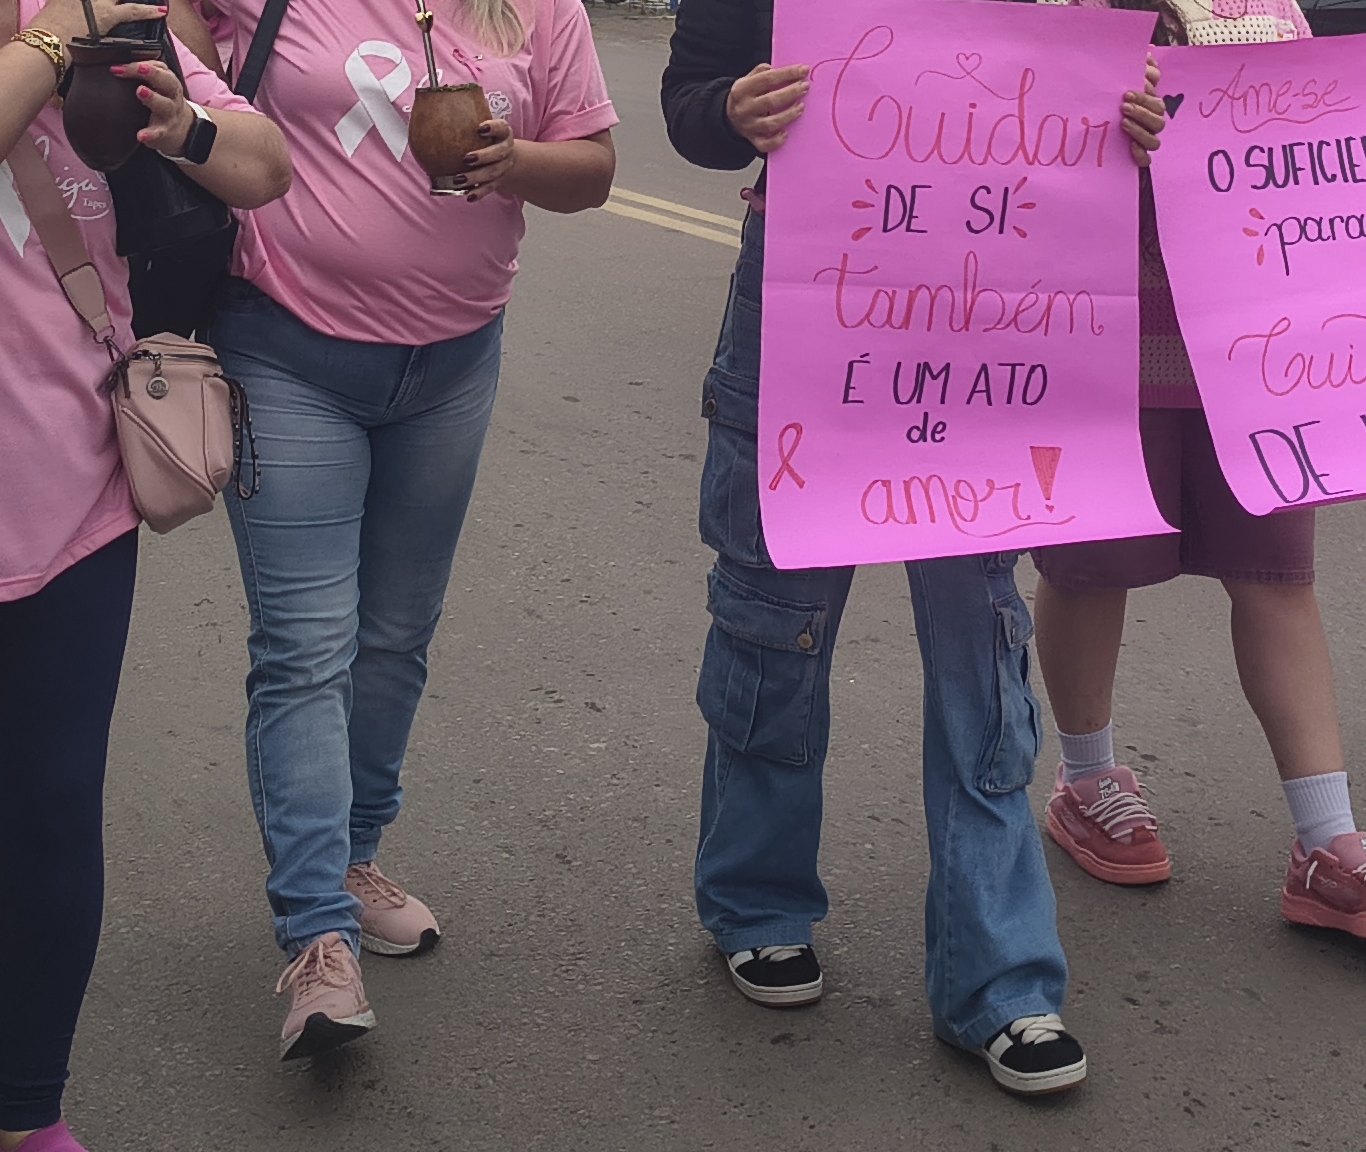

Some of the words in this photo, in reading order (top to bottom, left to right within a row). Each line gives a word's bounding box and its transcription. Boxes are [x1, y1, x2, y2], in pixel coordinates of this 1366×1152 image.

[810, 25, 1110, 168] Cuidar
[1207, 149, 1235, 192] O
[882, 184, 933, 234] DE
[965, 185, 1010, 235] SI
[813, 250, 1104, 337] também
[842, 352, 871, 405] É
[892, 360, 951, 406] UM
[966, 362, 1049, 407] ATO
[905, 411, 948, 445] de
[1249, 420, 1354, 504] DE
